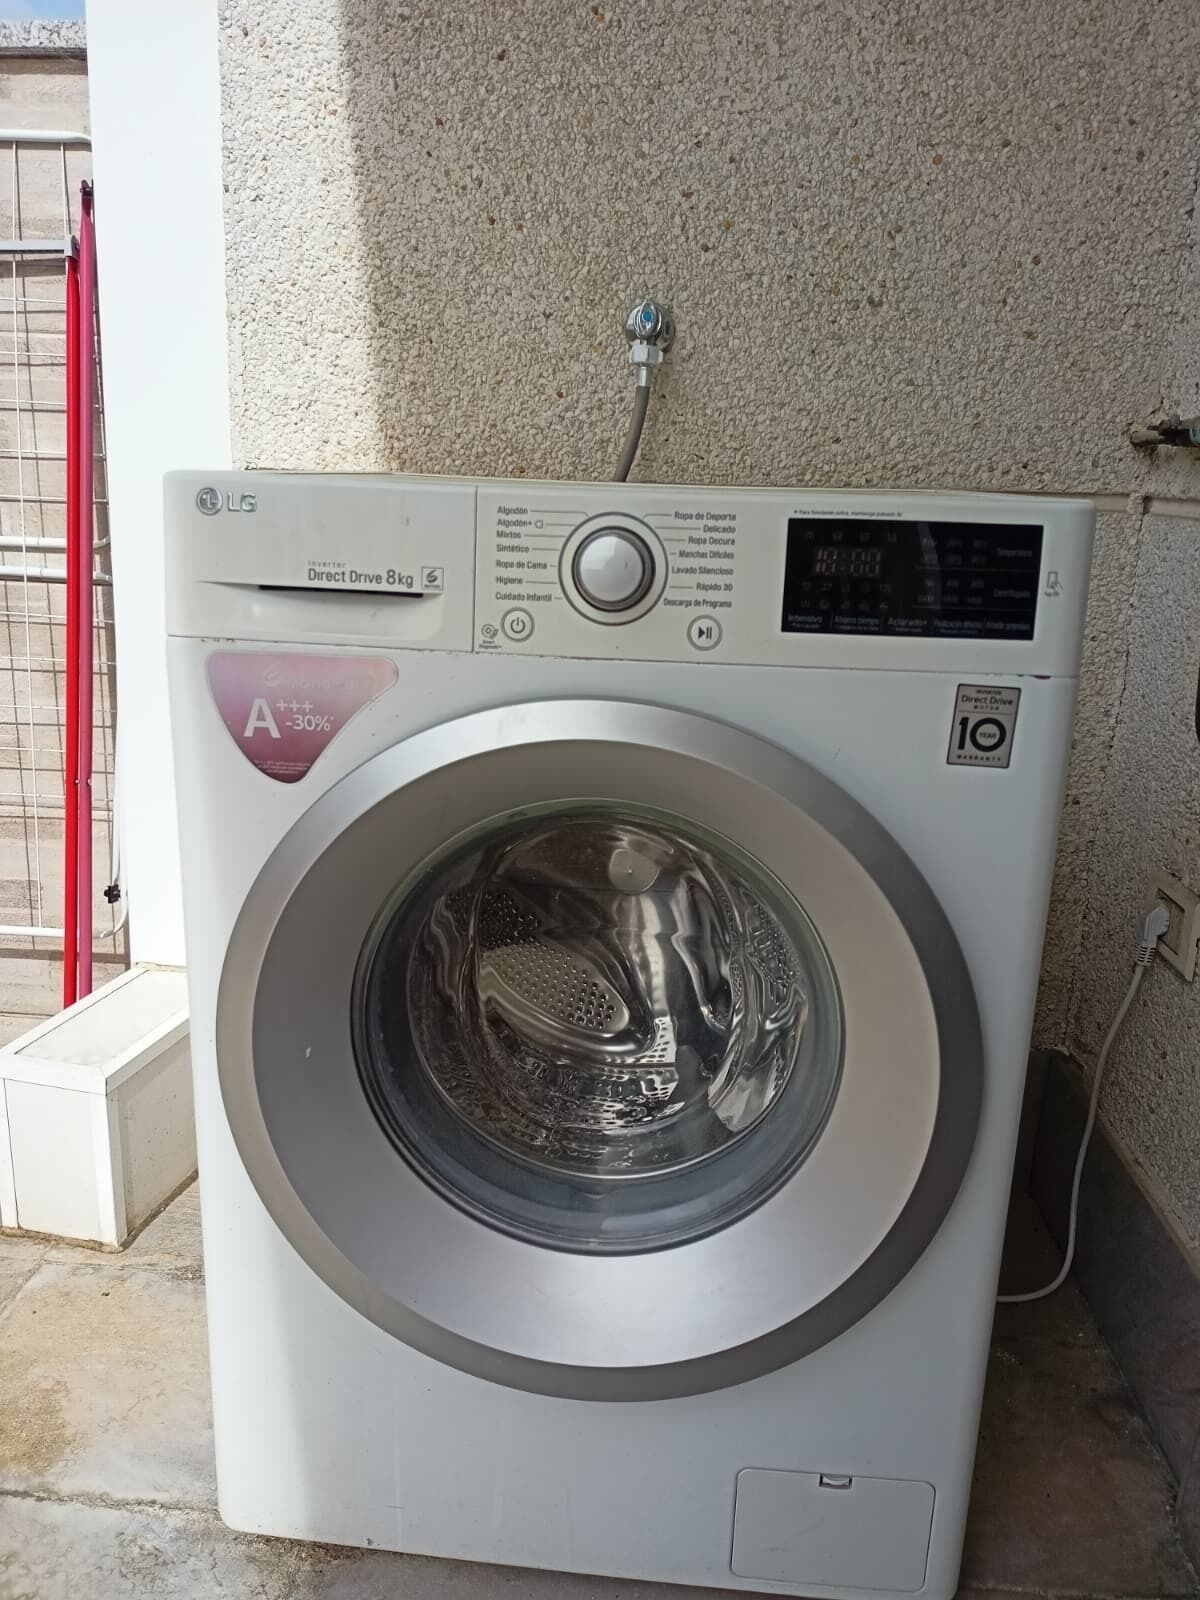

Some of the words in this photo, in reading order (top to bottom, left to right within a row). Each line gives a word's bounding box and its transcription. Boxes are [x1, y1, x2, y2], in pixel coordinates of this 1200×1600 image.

[227, 491, 257, 512] LG
[497, 505, 528, 516] Algodón
[674, 511, 693, 522] Ropa
[695, 511, 705, 520] de
[706, 511, 736, 522] Deporte
[496, 529, 522, 539] Mixtos
[703, 524, 736, 534] Delicado
[688, 535, 707, 546] Ropa
[709, 536, 736, 546] Oscura
[496, 543, 530, 553] Sintético
[678, 549, 708, 559] Manchas
[496, 559, 514, 571] Ropa
[516, 559, 526, 569] de
[527, 560, 547, 570] Cama
[672, 565, 698, 575] Lavado
[698, 566, 734, 576] Silencioso
[308, 567, 347, 583] Direct
[349, 570, 383, 585] Drive
[495, 575, 523, 586] Higiene
[696, 582, 722, 592] Rápido
[723, 583, 733, 592] 30
[495, 591, 525, 602] Cuidado
[526, 592, 552, 602] Infantil
[663, 597, 692, 609] Descarga
[693, 598, 702, 607] de
[702, 598, 732, 610] Programa
[961, 694, 988, 704] Direct
[989, 696, 1013, 705] Drive
[958, 716, 1006, 752] 10
